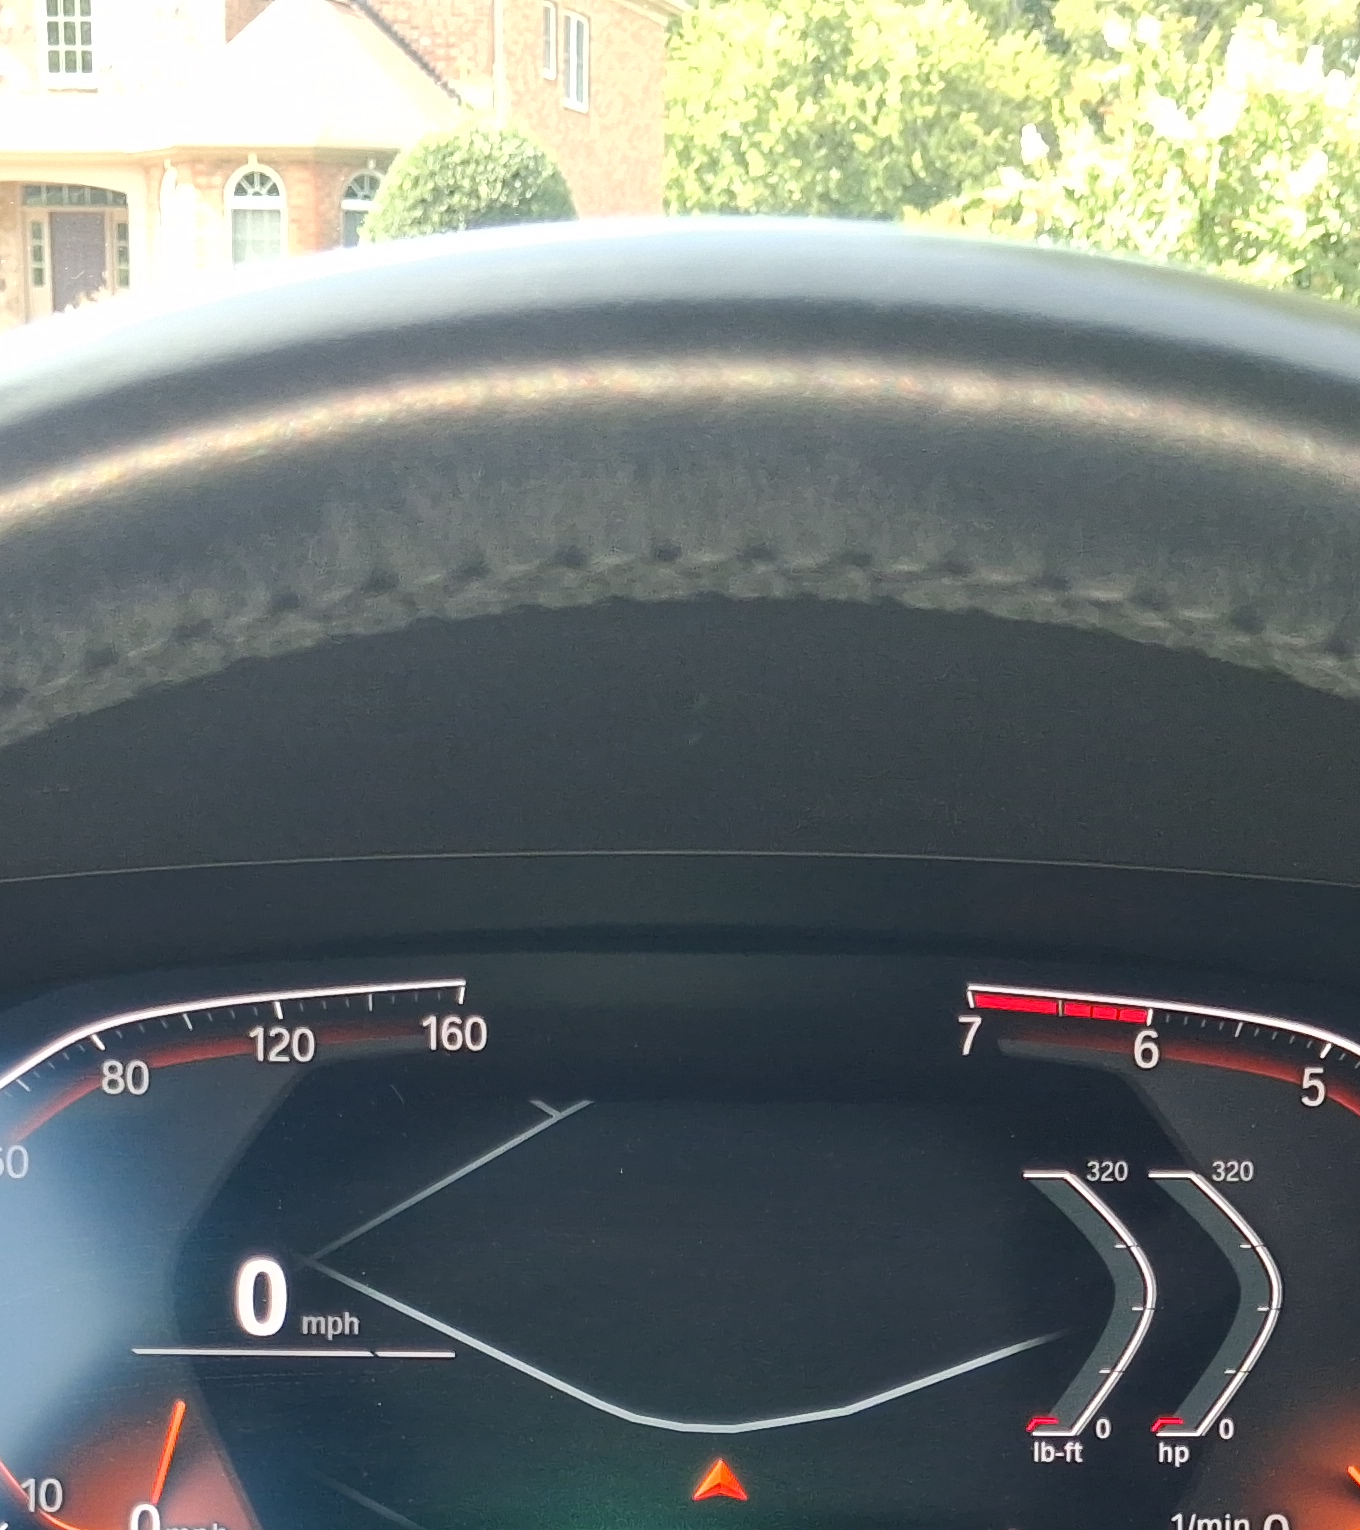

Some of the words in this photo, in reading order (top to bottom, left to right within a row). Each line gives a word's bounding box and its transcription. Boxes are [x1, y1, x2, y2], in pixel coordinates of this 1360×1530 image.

[248, 1026, 315, 1064] 120
[421, 1015, 487, 1052] 160
[958, 1015, 983, 1056] 7
[1134, 1030, 1159, 1069] 6
[100, 1059, 150, 1096] 80
[1300, 1067, 1326, 1107] 5
[1086, 1160, 1129, 1183] 320
[1211, 1160, 1254, 1183] 320
[234, 1255, 288, 1337] 0
[301, 1311, 360, 1342] mph
[1095, 1418, 1111, 1440] 0
[1218, 1418, 1234, 1440] 0
[1032, 1440, 1083, 1464] lb-ft
[1157, 1441, 1190, 1467] hp
[21, 1478, 63, 1514] 10
